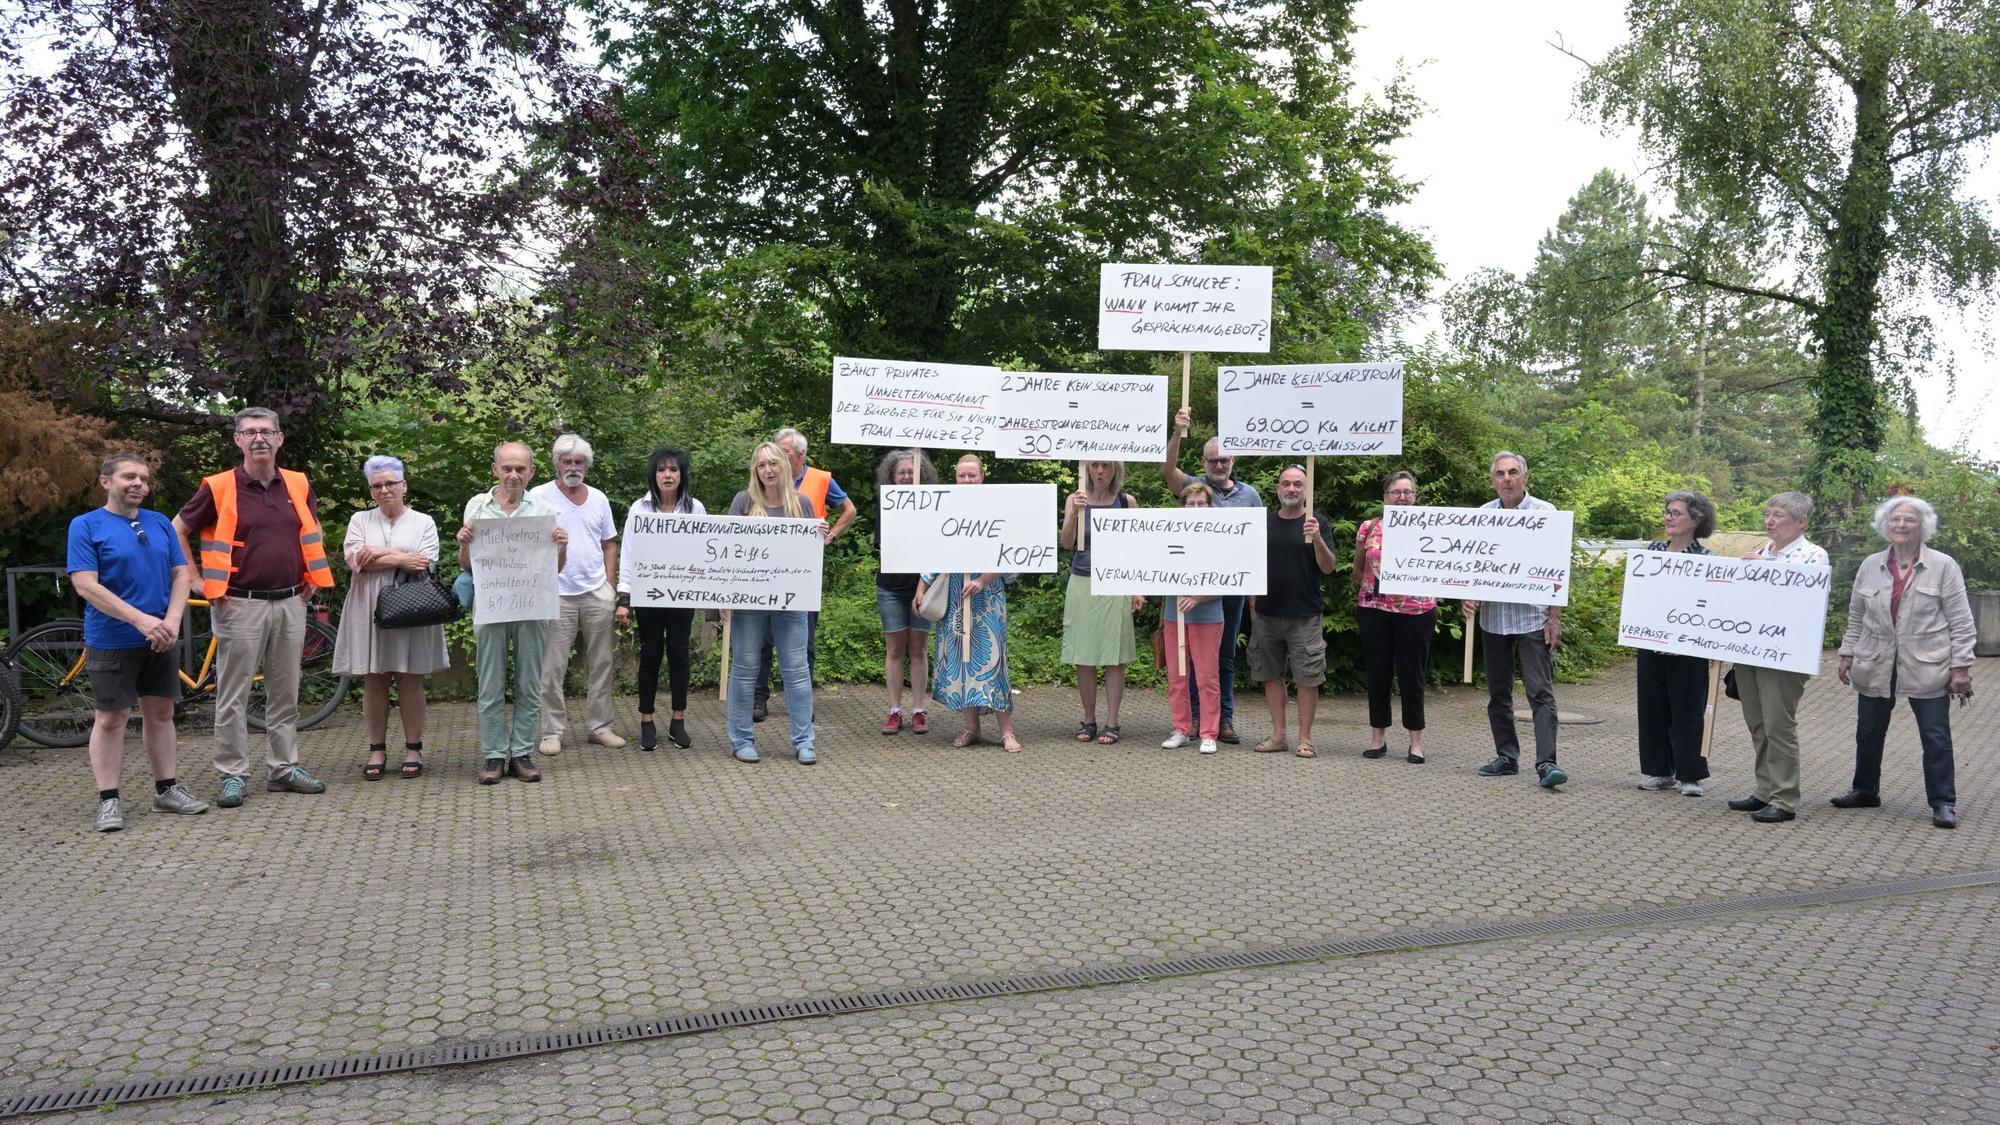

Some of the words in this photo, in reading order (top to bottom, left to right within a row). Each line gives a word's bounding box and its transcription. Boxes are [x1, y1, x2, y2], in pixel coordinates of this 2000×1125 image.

[1121, 271, 1162, 288] FRAU
[1105, 297, 1147, 312] WANN
[1154, 301, 1200, 313] KOMMT
[840, 362, 880, 377] ZÄHLT
[885, 366, 939, 379] PRIVATES
[1000, 375, 1014, 392] 2
[1015, 377, 1061, 392] JAHRE
[1223, 370, 1240, 393] 2
[1244, 371, 1287, 390] JAHRE
[865, 384, 990, 405] UMWELTENGAGEMENT
[836, 401, 861, 413] DER
[863, 403, 919, 418] BÜRGER
[923, 409, 945, 420] FÜR
[860, 424, 893, 438] FRAU
[1136, 423, 1163, 434] VON
[1245, 417, 1310, 434] 69.000
[1317, 420, 1339, 434] KG
[1018, 434, 1053, 454] 30
[1222, 436, 1287, 449] ERSPARTE
[882, 489, 951, 511] STADT
[634, 515, 818, 539] DACHFLÄCHENNUTZUNGSVERTRAG
[941, 517, 1006, 538] OHNE
[1092, 517, 1252, 536] VERTRAUENSVERLUST
[1387, 510, 1548, 531] BÜRGERSOLARANLAGE
[480, 527, 540, 545] Mietvertrag
[996, 543, 1056, 567] KOPF
[1419, 536, 1436, 554] 2
[1440, 536, 1502, 556] JAHRE
[1395, 557, 1521, 575] VERTRAGSBRUCH
[1527, 565, 1566, 581] OHNE
[1631, 554, 1646, 577] 2
[1649, 556, 1705, 578] JAHRE
[1095, 567, 1251, 587] VERWALTUNGSFRUST
[1381, 570, 1420, 582] REAKTION
[1422, 575, 1439, 584] DER
[1622, 624, 1673, 640] VERPASSTE
[1666, 609, 1752, 634] 600.000
[1758, 623, 1787, 638] KM
